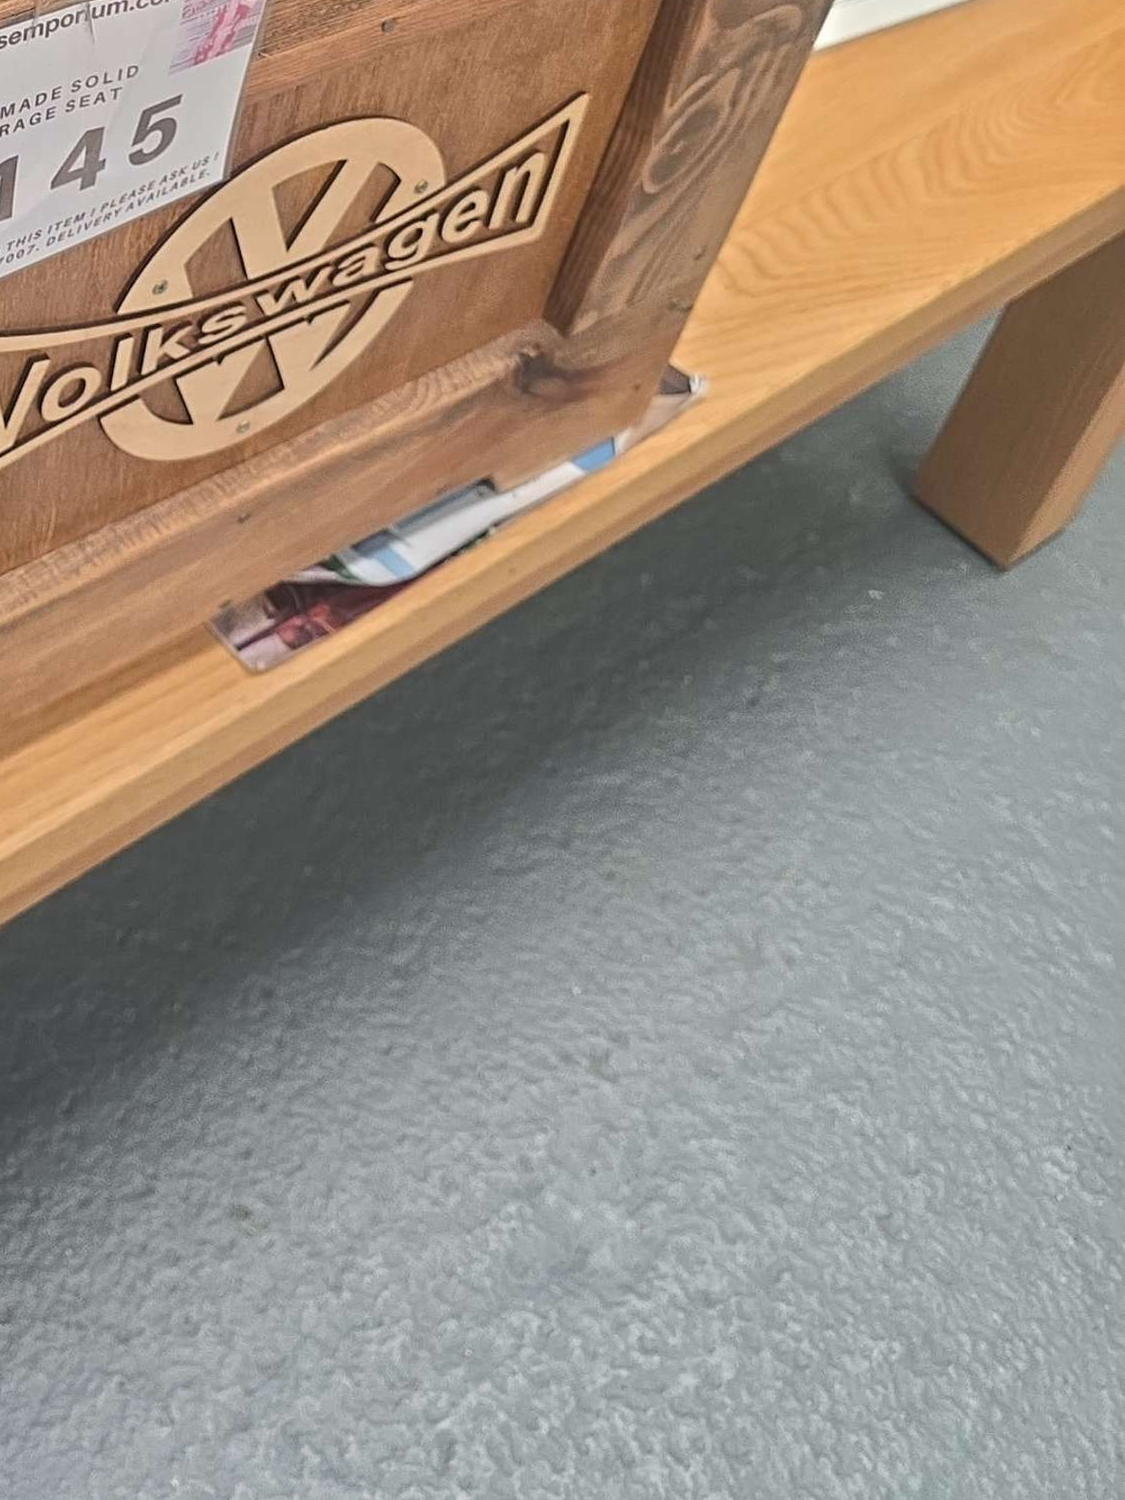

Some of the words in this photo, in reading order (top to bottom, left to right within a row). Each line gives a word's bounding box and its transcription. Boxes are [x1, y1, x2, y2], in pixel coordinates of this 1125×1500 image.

[0, 86, 63, 120] MADE
[70, 64, 141, 93] SOLID
[65, 87, 124, 114] SEAT
[6, 228, 43, 251] THIS
[47, 211, 86, 235] ITEM
[100, 179, 156, 213] PLEASE
[158, 165, 188, 186] ASK
[191, 155, 211, 170] US
[46, 207, 124, 247] DELIVERY
[125, 170, 211, 213] AVAILABLE.
